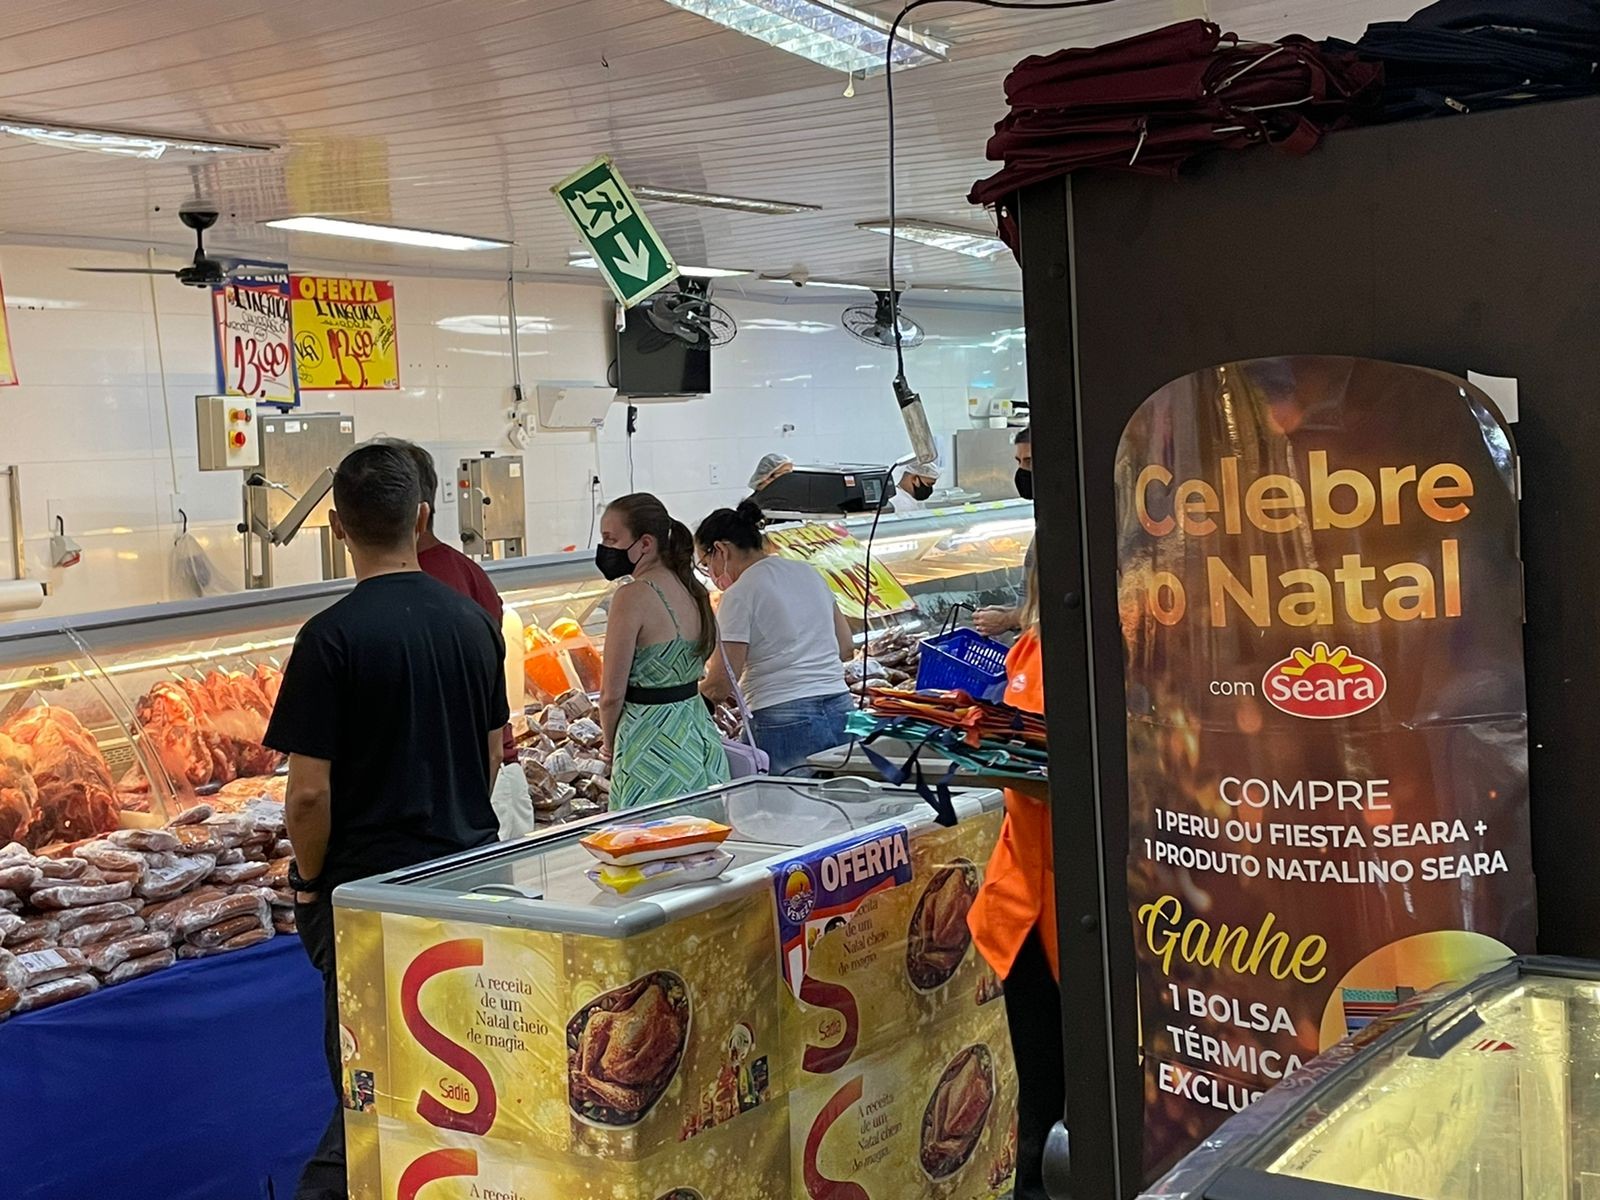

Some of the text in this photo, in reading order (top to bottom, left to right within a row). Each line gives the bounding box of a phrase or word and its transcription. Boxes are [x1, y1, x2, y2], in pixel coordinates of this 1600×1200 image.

[299, 277, 378, 302] OFERTA
[1135, 449, 1475, 537] Celebre
[1148, 539, 1462, 628] o Natal
[1209, 673, 1375, 702] com Seara
[1219, 776, 1393, 811] COMPRE
[1155, 808, 1488, 849] 1 PERU OU FIESTA SEARA +
[820, 833, 909, 892] OFERTA
[1144, 838, 1509, 883] 1 PRODUTO NATALINO SEARA
[1137, 895, 1328, 984] Ganhe
[474, 972, 532, 995] A receita
[480, 992, 522, 1013] de um
[1168, 983, 1297, 1037] 1 BOLSA
[466, 1027, 529, 1053] de magia.
[476, 1009, 549, 1036] Natal cheio
[1166, 1025, 1302, 1079] TÉRMICA
[438, 1077, 470, 1102] Sadia
[470, 1184, 480, 1197] A
